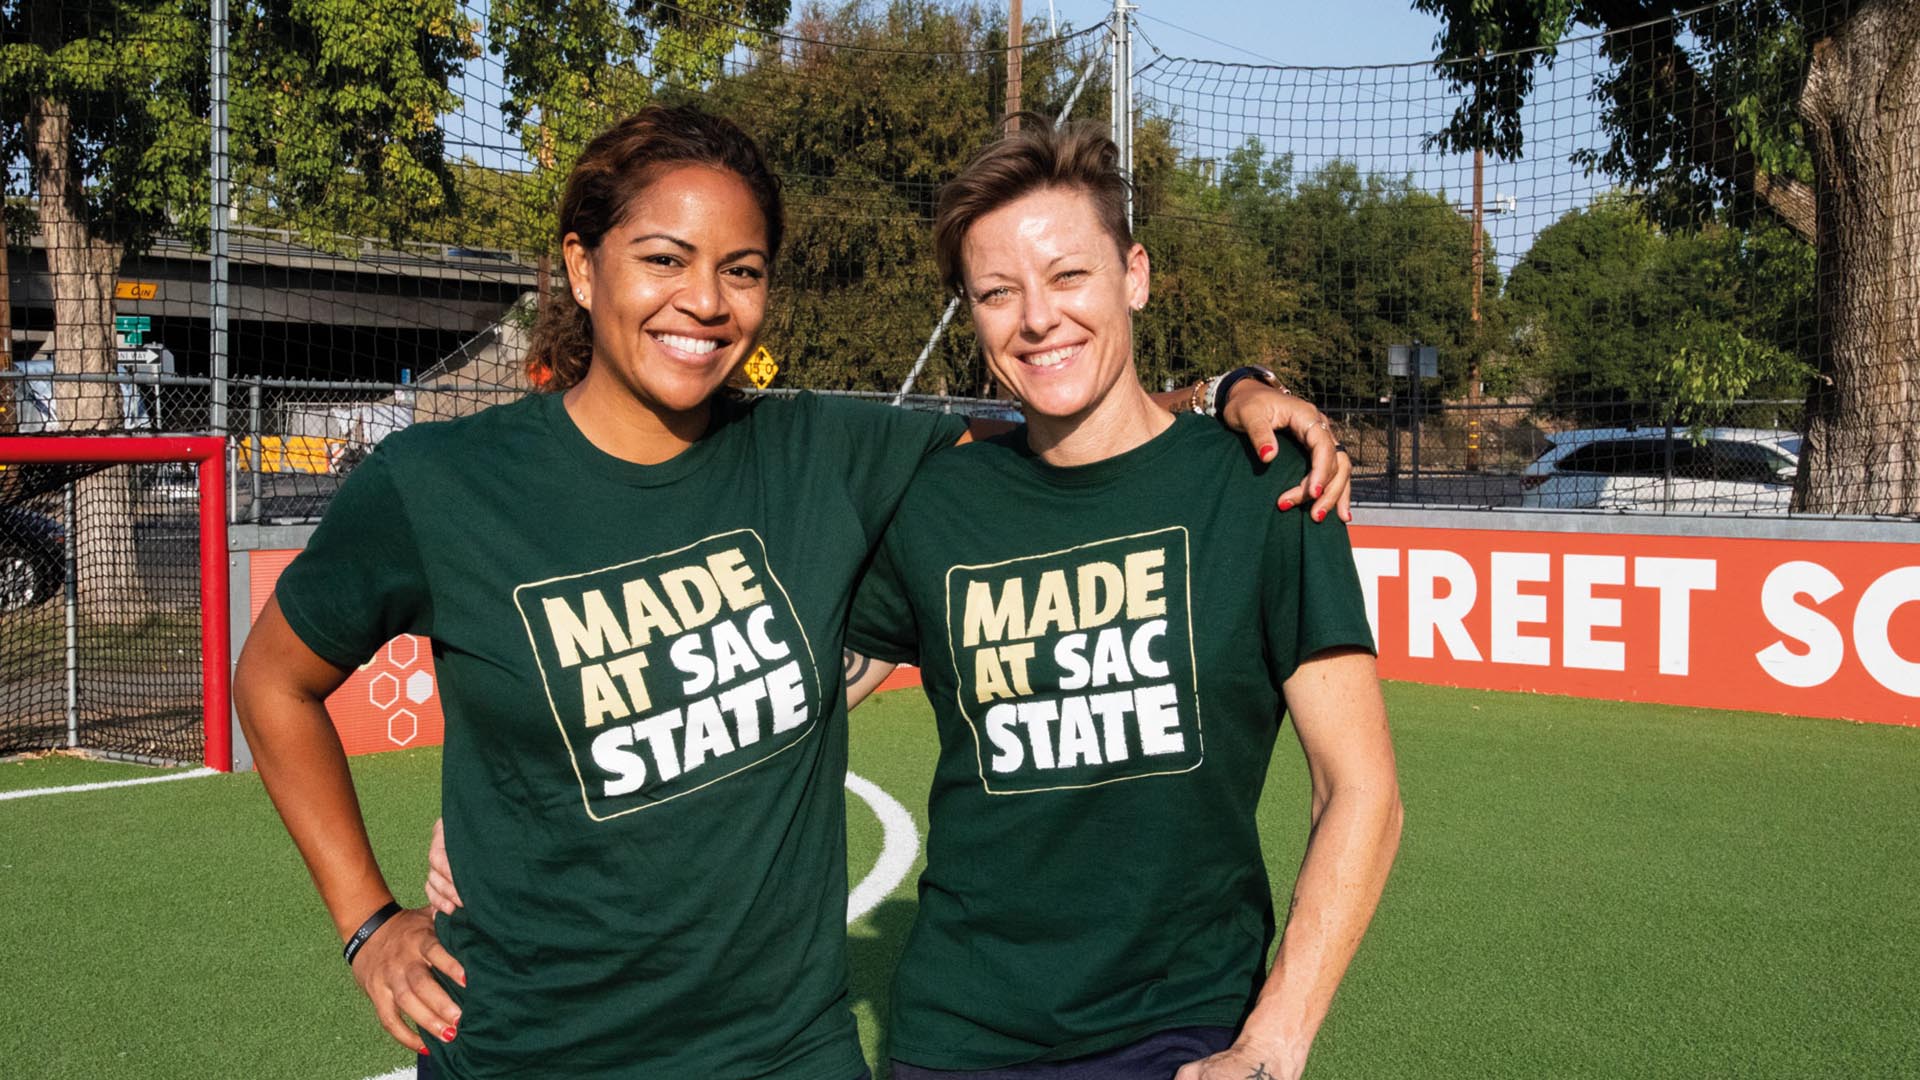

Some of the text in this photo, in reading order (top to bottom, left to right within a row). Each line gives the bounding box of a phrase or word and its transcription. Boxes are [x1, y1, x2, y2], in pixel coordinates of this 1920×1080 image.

[130, 351, 146, 360] WAY
[542, 548, 766, 668] MADE
[963, 548, 1167, 648] MADE
[1351, 547, 1717, 677] TREET
[580, 605, 790, 728] AT SAC
[975, 619, 1170, 704] AT SAC
[591, 660, 808, 797] STATE
[985, 683, 1185, 773] STATE
